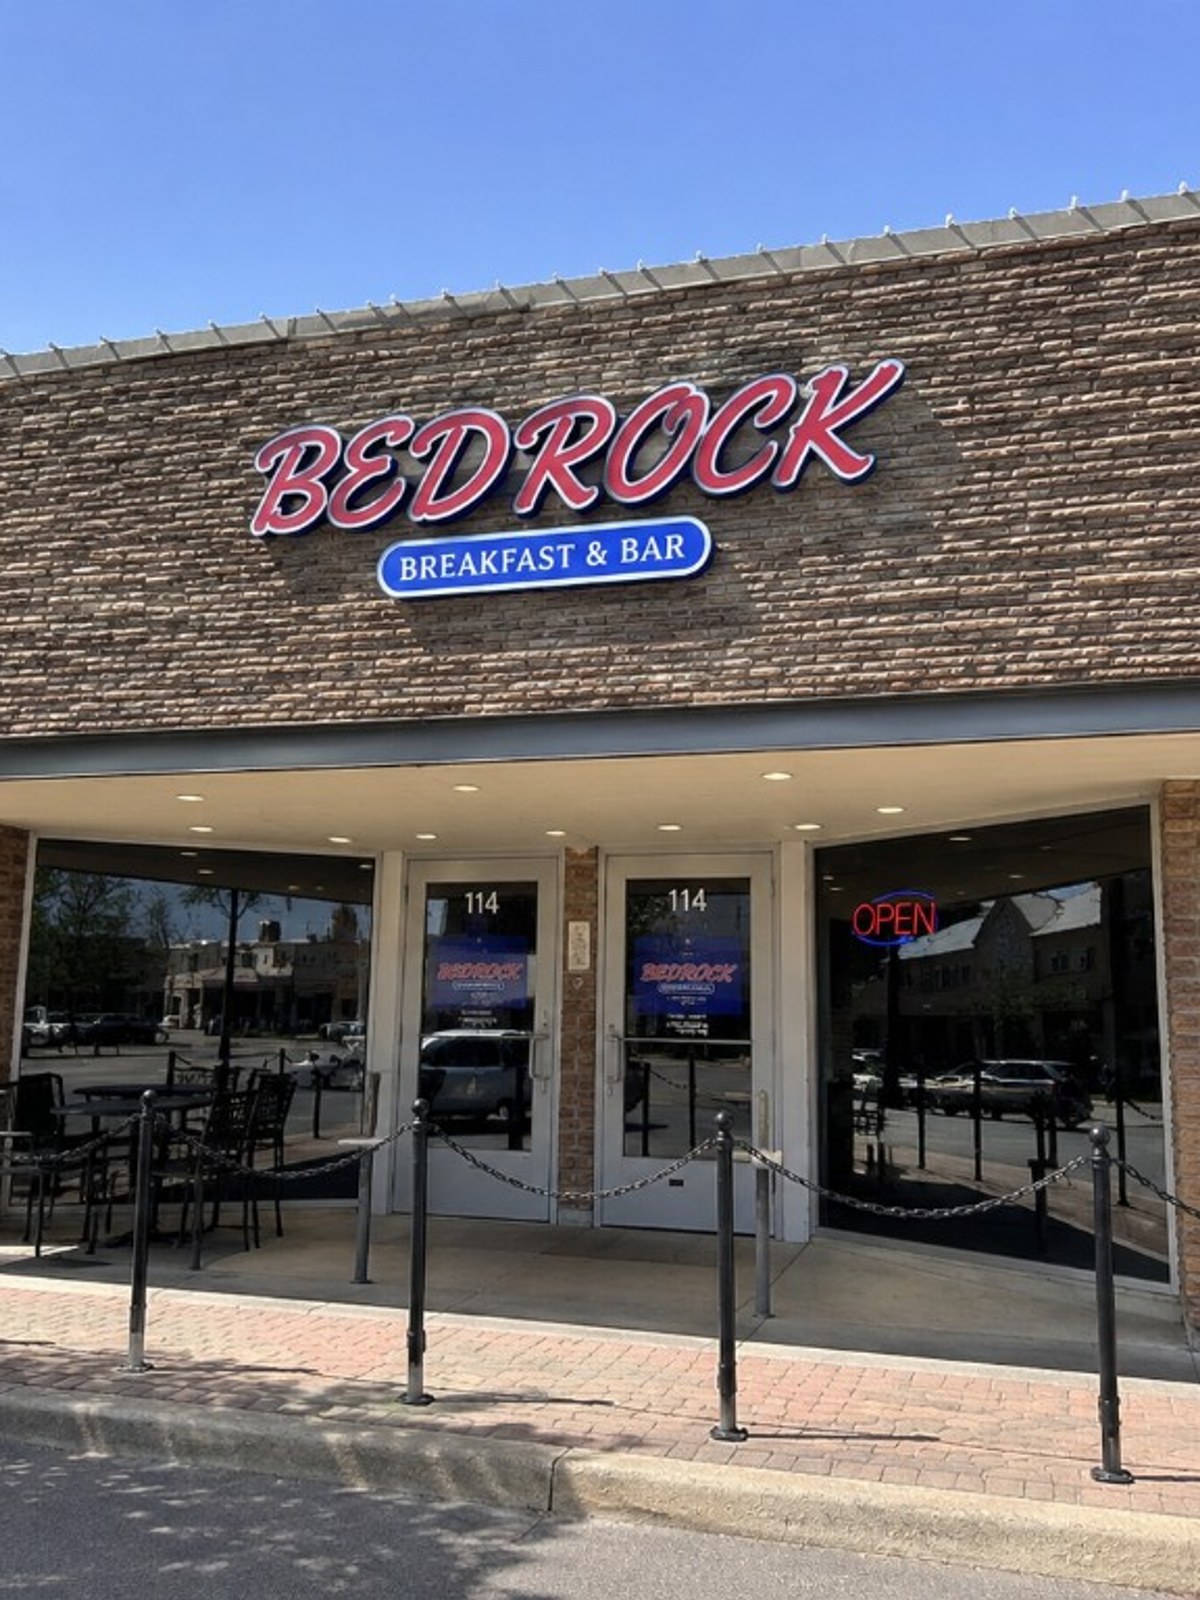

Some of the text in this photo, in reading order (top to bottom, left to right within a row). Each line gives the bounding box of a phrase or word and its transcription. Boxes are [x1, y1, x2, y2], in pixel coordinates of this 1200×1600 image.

[250, 358, 904, 536] BEDROCK
[399, 533, 685, 581] BREAKFAST & BAR
[464, 891, 500, 914] 114
[669, 888, 707, 912] 114
[852, 901, 937, 935] OPEN
[640, 963, 738, 982] BEDROCK
